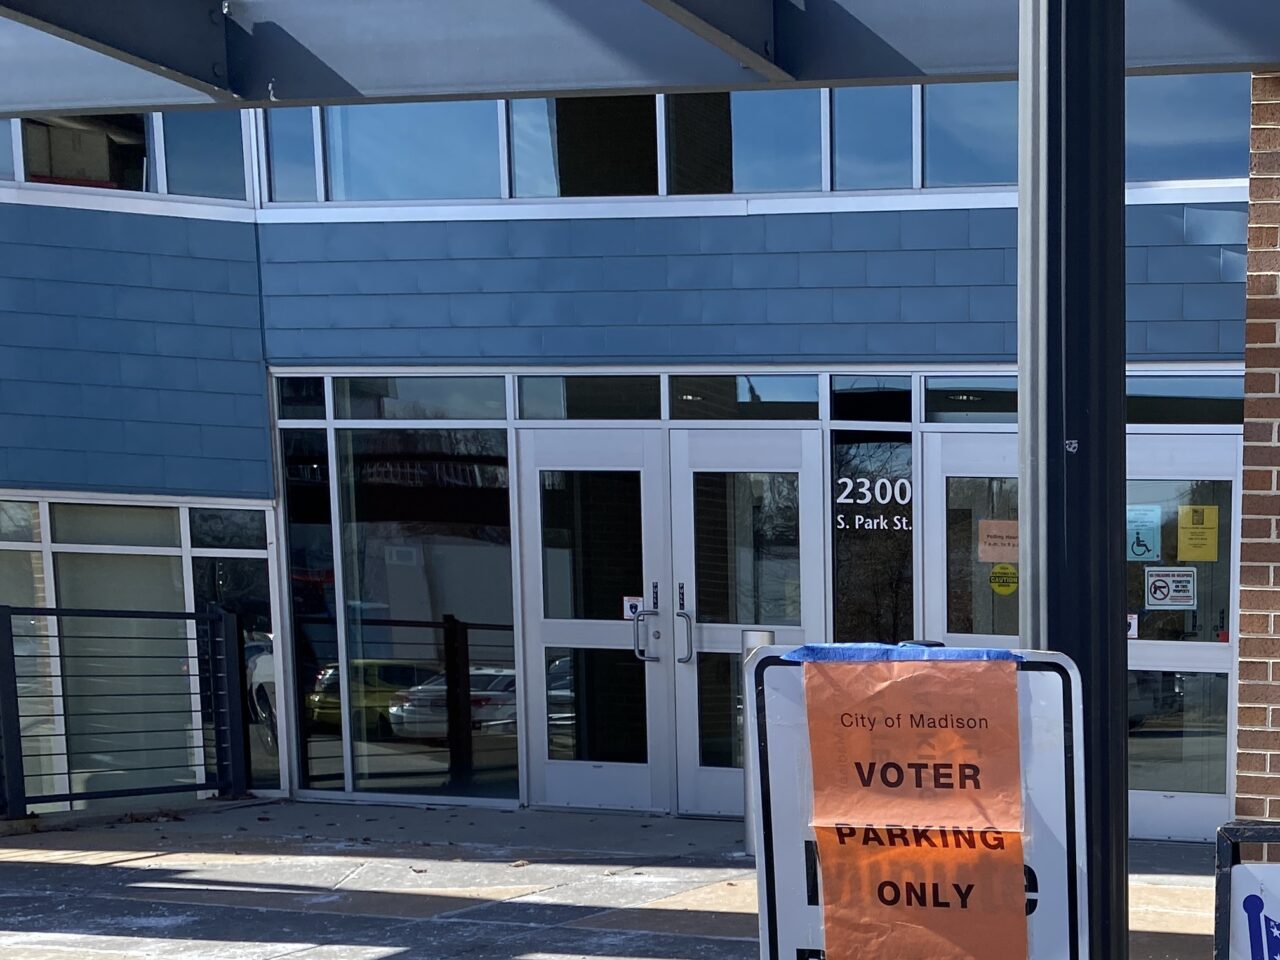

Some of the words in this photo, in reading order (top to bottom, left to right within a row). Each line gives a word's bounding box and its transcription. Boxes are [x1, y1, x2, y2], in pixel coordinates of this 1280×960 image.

[836, 477, 912, 505] 2300
[836, 514, 850, 529] S.
[855, 514, 889, 530] Park
[893, 515, 913, 530] St.
[840, 712, 876, 732] City
[884, 713, 902, 729] of
[910, 713, 989, 729] Madison
[854, 761, 982, 790] VOTER
[835, 822, 1006, 851] PARKING
[877, 880, 976, 909] ONLY
